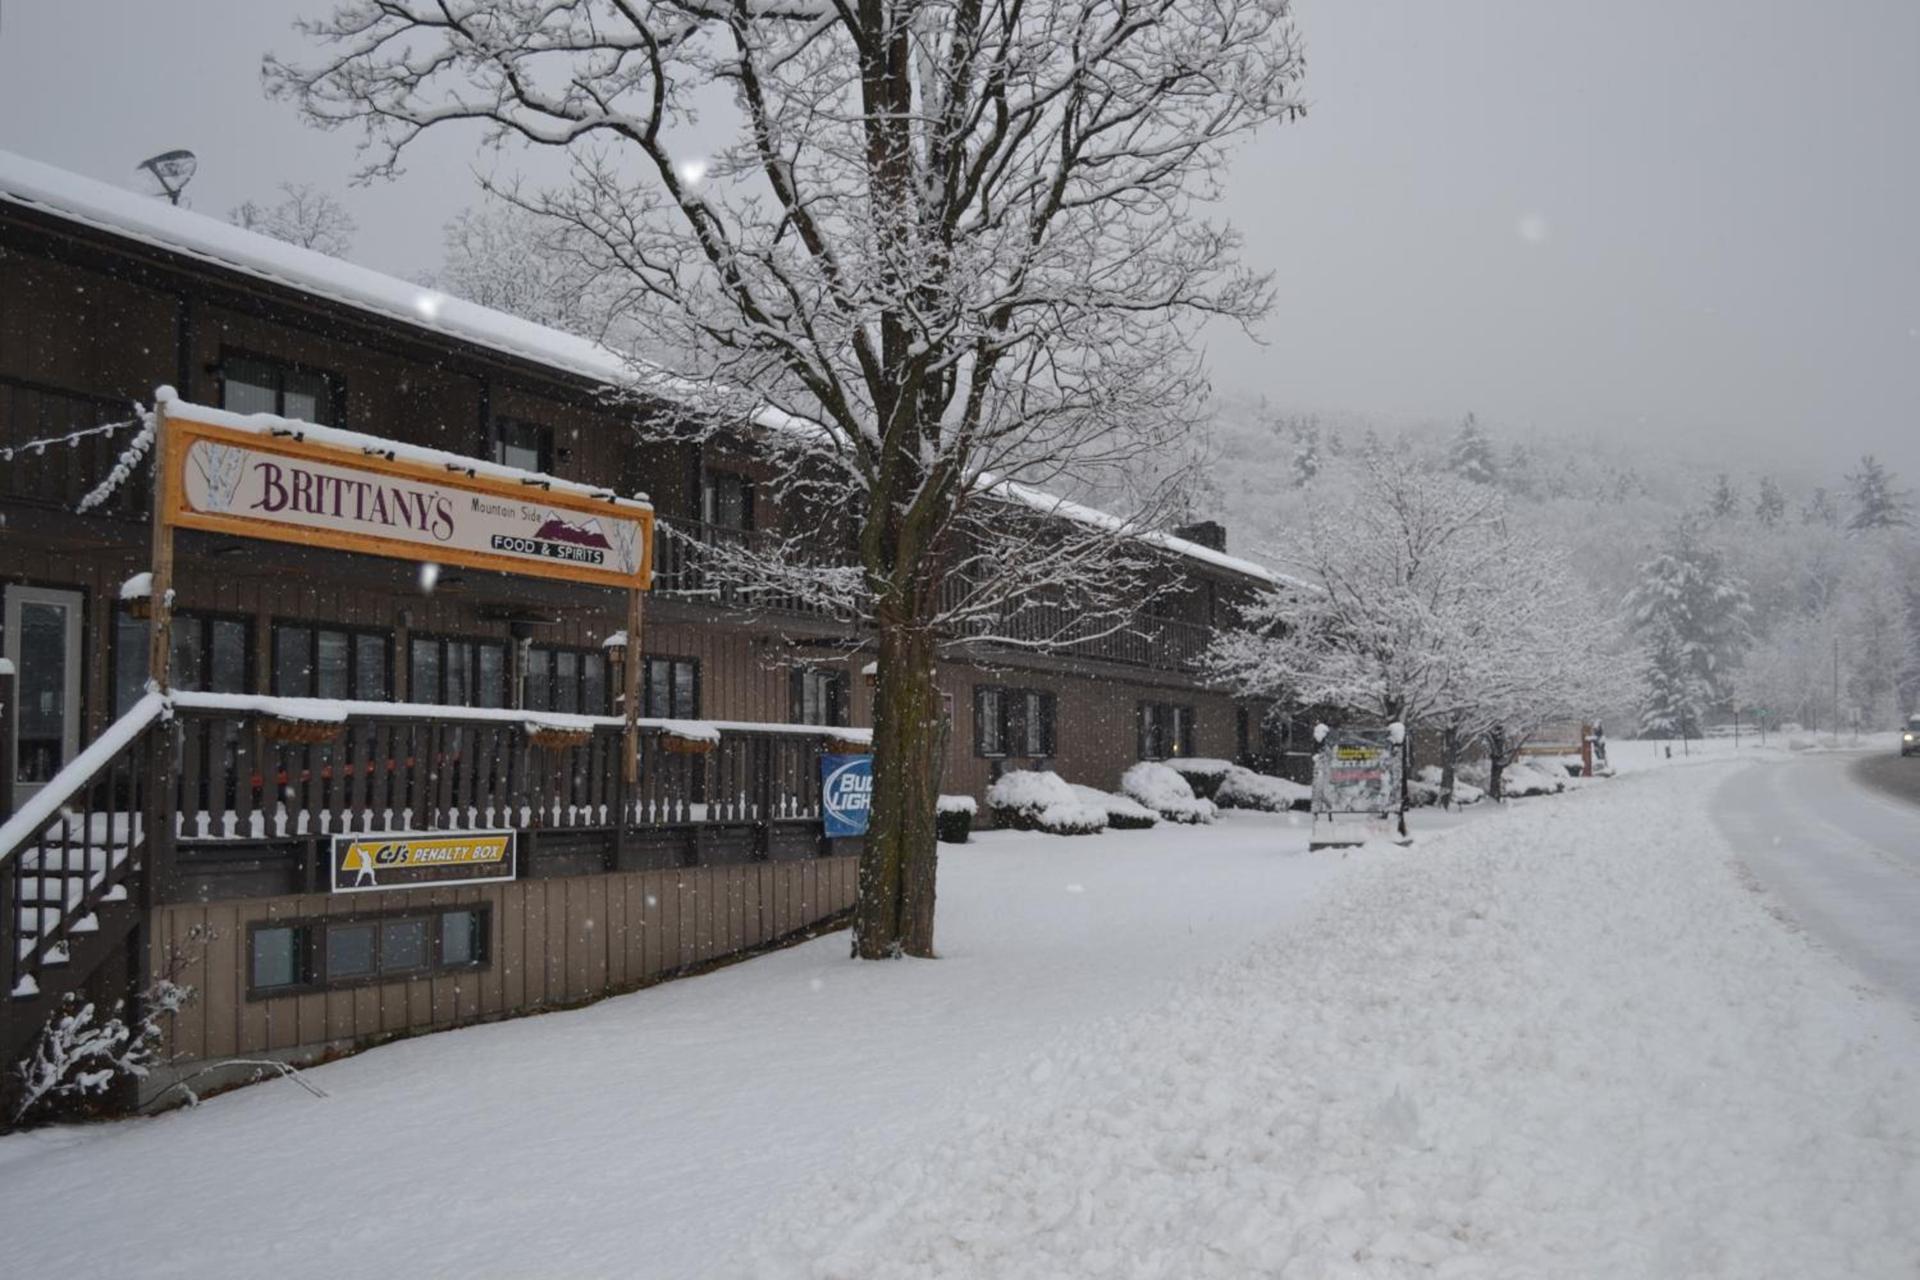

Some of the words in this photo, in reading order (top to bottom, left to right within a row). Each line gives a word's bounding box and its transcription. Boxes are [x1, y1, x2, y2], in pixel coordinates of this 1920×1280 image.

[250, 462, 454, 542] BRITTANY'S
[471, 498, 516, 519] Mountain
[522, 506, 542, 523] Side
[494, 536, 535, 552] FOOD
[541, 545, 551, 556] &
[557, 546, 602, 564] SPIRITS
[831, 792, 871, 810] LIGH
[413, 846, 470, 862] PENALTY
[472, 846, 499, 859] BOX
